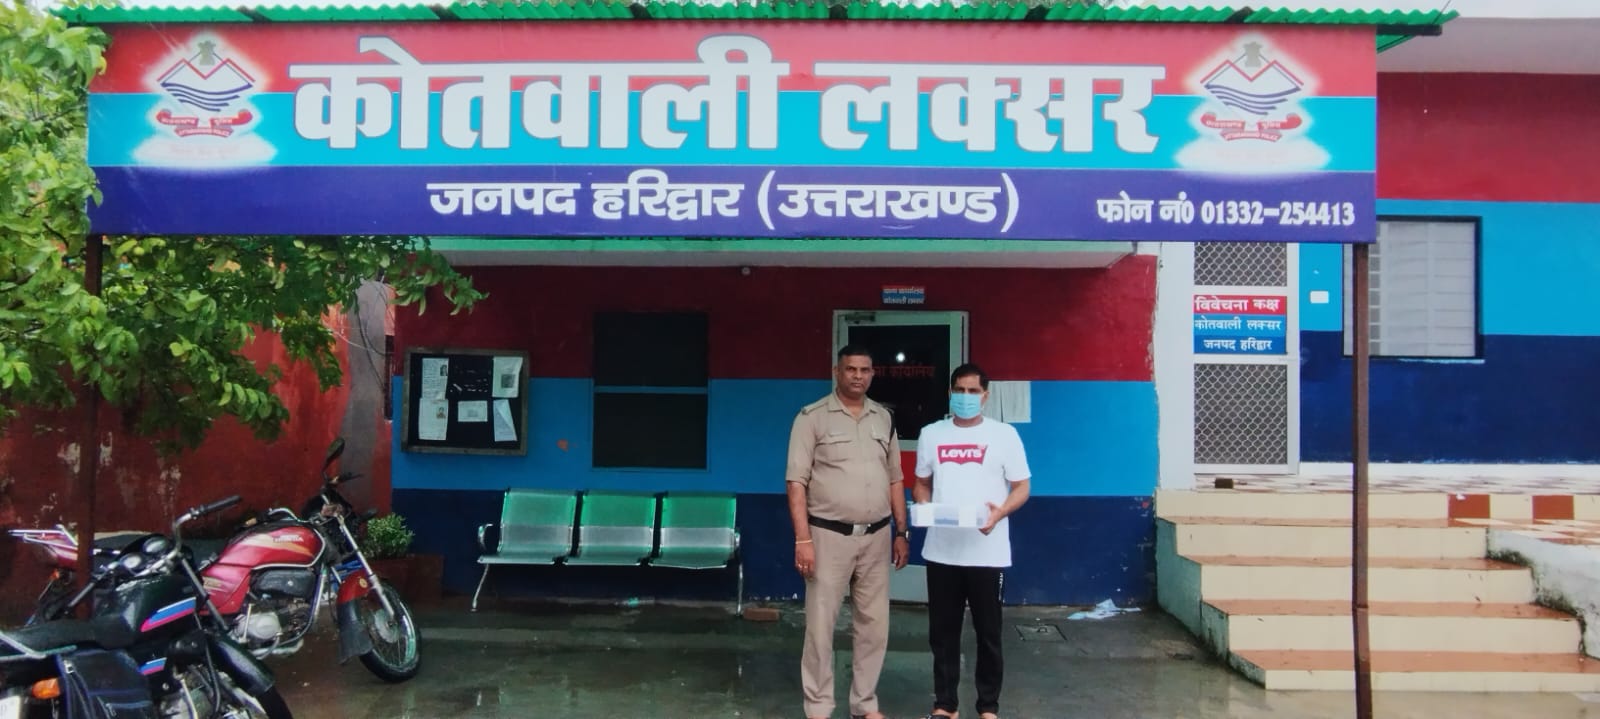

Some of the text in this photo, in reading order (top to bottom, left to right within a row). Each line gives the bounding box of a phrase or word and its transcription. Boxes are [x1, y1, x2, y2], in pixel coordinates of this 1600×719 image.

[288, 34, 1166, 153] कोतवाली लक्सर
[427, 169, 1020, 233] जनपद हरिद्वार (उत्तराखण्ड)
[1097, 191, 1154, 224] फोन
[1201, 200, 1355, 226] 01332-254413
[1194, 295, 1280, 312] विवेचना कक्ष
[1194, 315, 1282, 331] कोतवाली लक्सर
[1203, 337, 1273, 351] जनपद हरिद्वार
